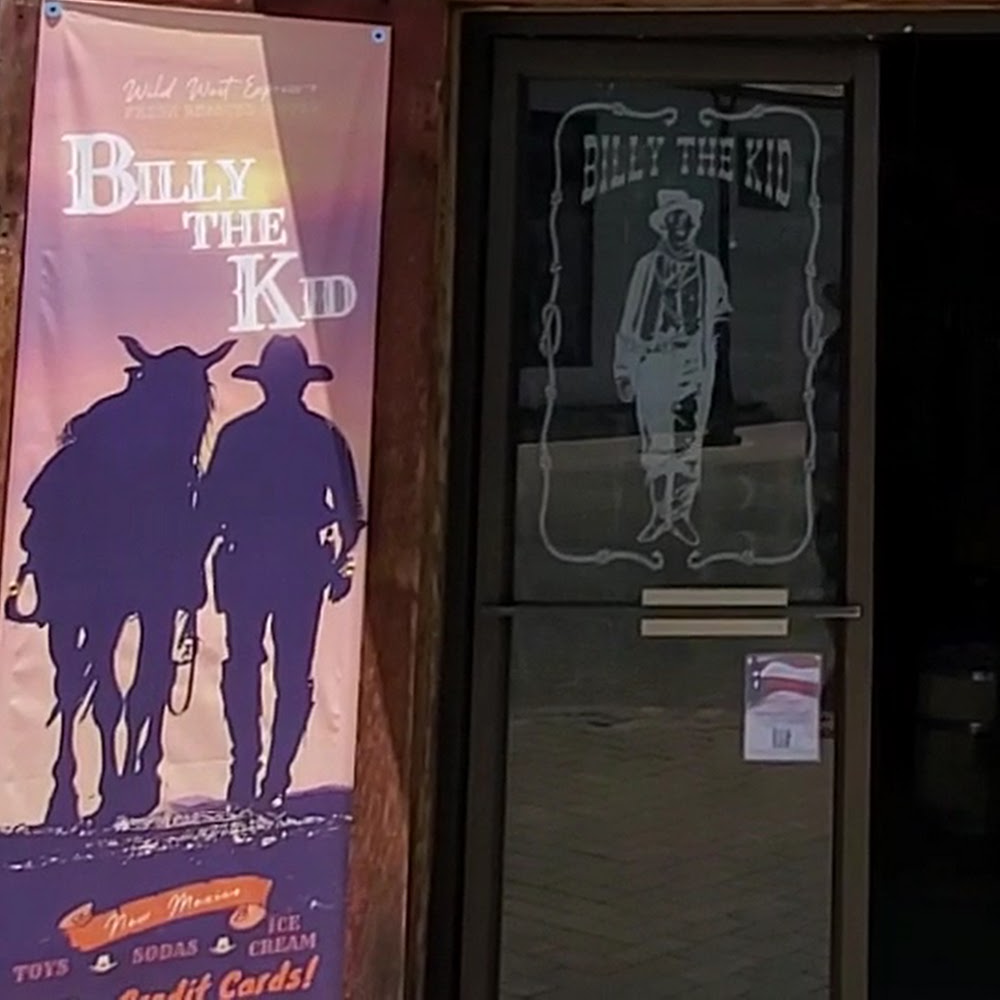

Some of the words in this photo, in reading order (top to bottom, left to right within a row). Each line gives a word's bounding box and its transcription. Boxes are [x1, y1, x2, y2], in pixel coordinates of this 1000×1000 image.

[122, 73, 178, 104] Wild
[581, 133, 665, 206] BILLY
[675, 136, 735, 182] THE
[744, 137, 793, 208] KID
[182, 207, 289, 251] THE
[104, 909, 151, 940] New
[166, 887, 242, 918] Mexico
[268, 913, 301, 934] ICE
[12, 958, 70, 983] TOYS
[132, 939, 199, 965] SODAS
[248, 931, 317, 957] CREAM
[219, 954, 320, 1000] Cards!
